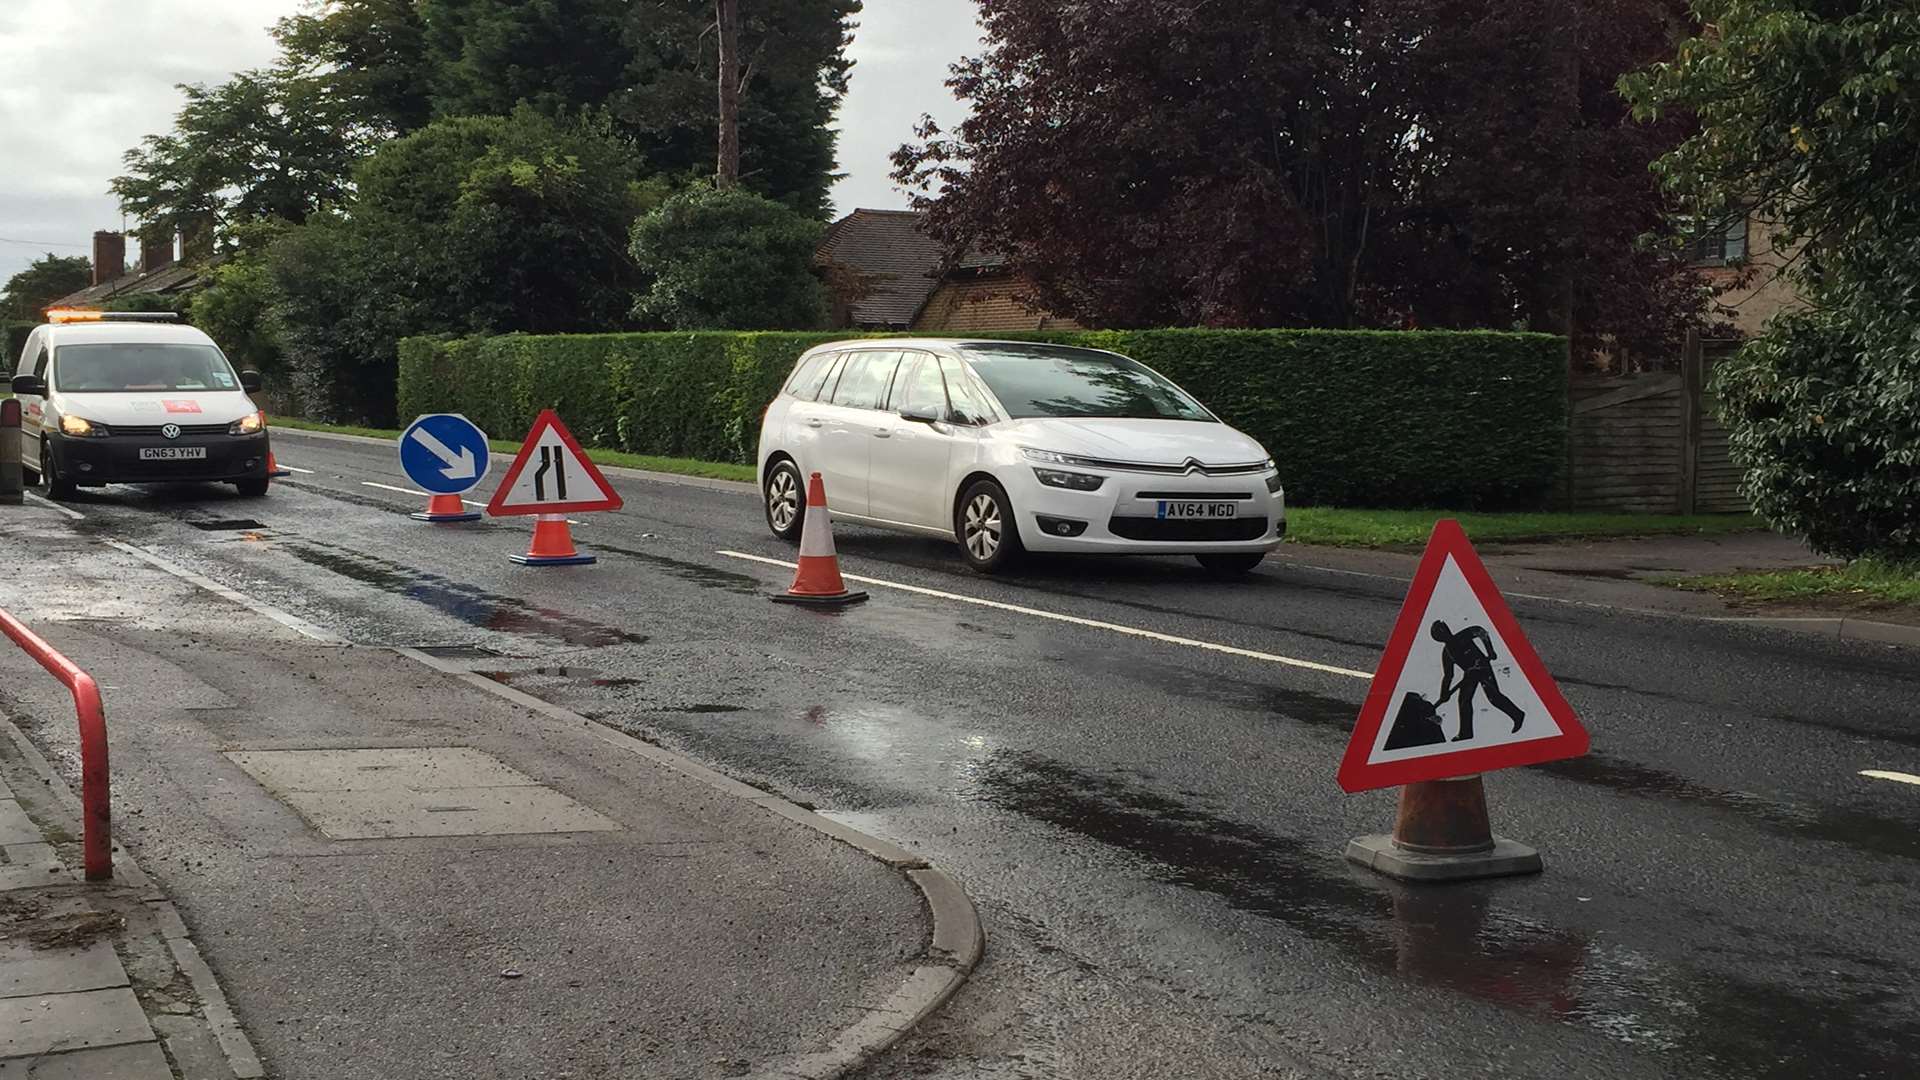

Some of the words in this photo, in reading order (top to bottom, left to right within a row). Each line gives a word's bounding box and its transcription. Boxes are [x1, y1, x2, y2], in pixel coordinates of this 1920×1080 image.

[144, 448, 175, 458] GN63
[179, 448, 201, 457] YHV
[1167, 503, 1204, 516] AV64
[1208, 503, 1234, 516] WGD
